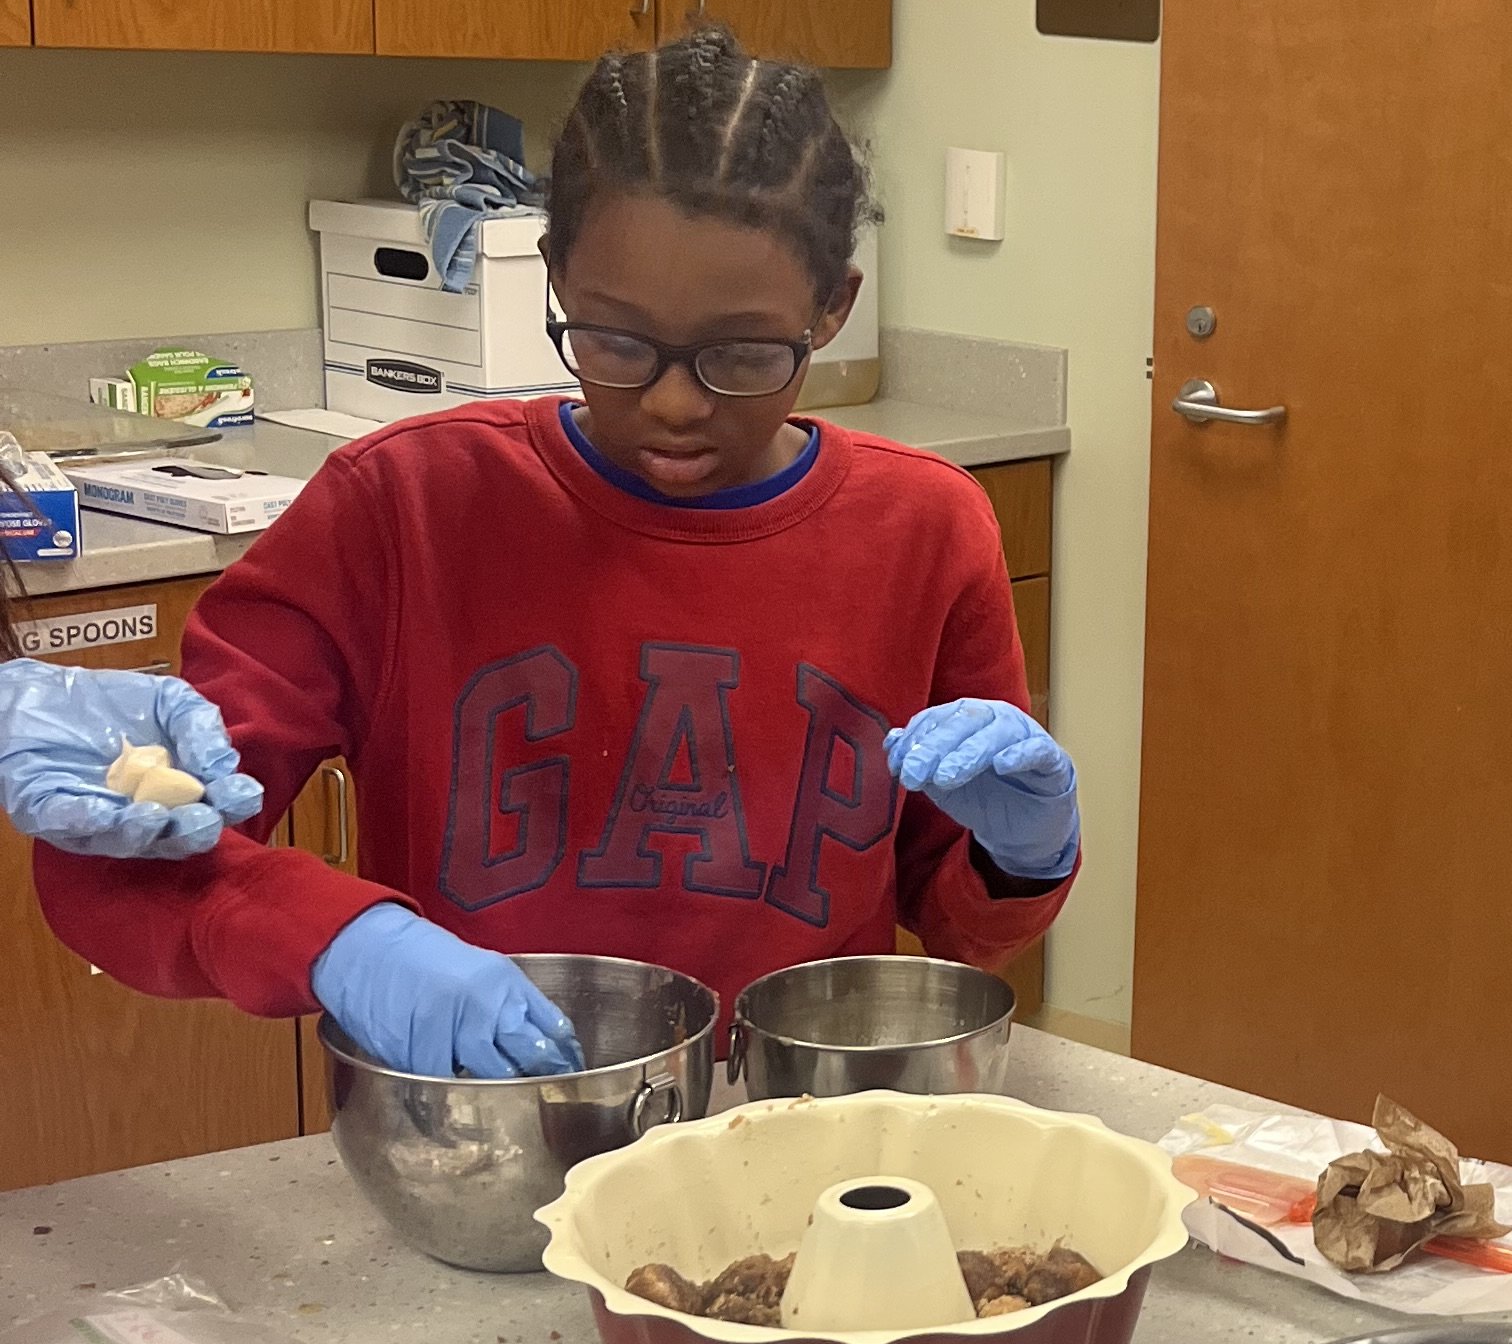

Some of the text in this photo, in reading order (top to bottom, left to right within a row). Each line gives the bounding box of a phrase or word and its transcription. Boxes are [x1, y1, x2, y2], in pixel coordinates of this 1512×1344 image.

[370, 366, 438, 387] BANKERS BOX
[84, 482, 135, 505] MONOGRAM
[50, 615, 153, 648] SPOONS
[437, 641, 899, 928] GAP
[630, 783, 731, 825] Original
